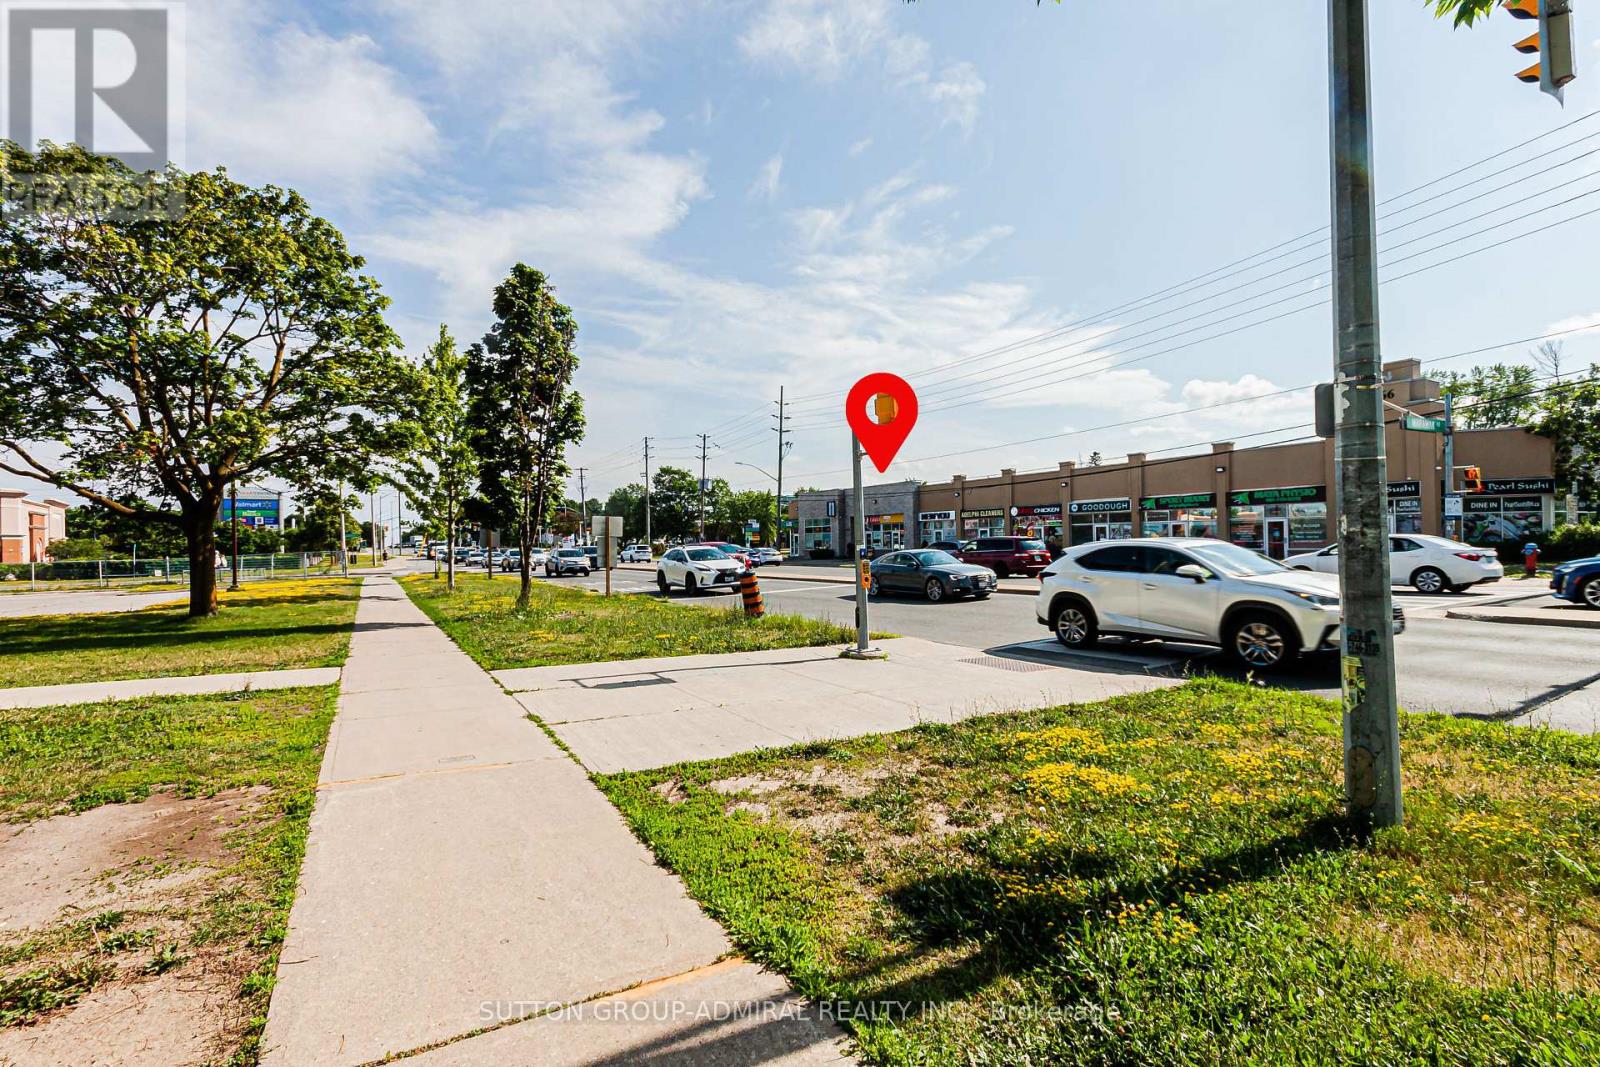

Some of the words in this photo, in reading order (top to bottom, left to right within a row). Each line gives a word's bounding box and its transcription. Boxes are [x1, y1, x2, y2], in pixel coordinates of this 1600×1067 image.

[1488, 482, 1515, 490] Pearl
[1517, 481, 1549, 490] Sushi
[1082, 503, 1128, 511] GOODOUGH
[980, 509, 1004, 517] CLEANERS
